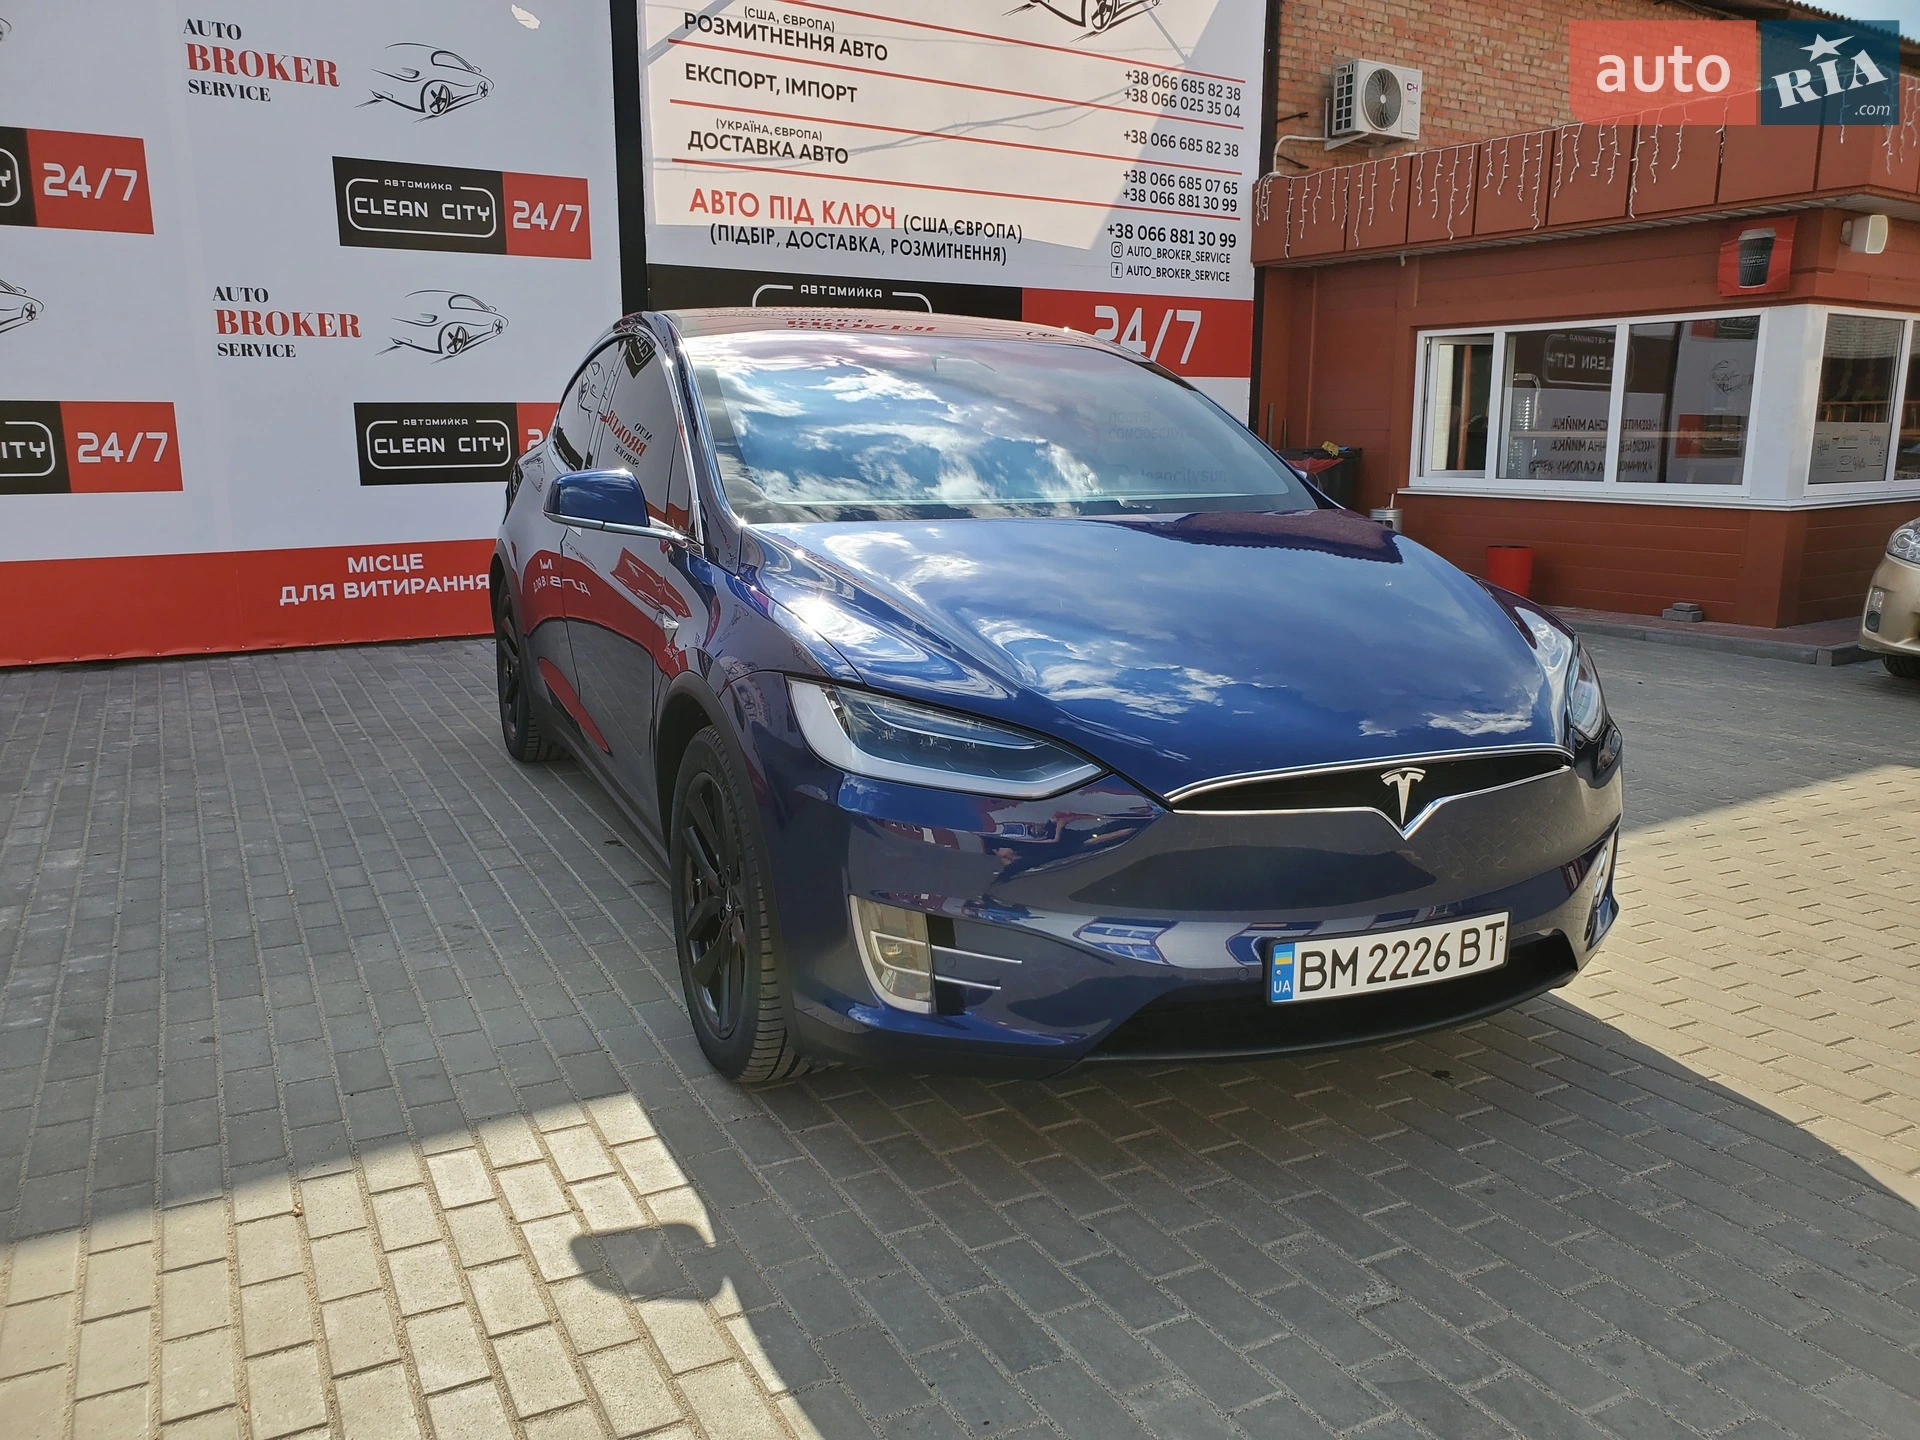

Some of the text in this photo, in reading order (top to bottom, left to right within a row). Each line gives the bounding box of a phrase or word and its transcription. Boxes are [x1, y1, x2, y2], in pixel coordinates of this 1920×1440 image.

[183, 18, 242, 40] AUTO
[744, 6, 835, 33] (США, ЄВРОПА)
[684, 11, 888, 61] РОЗМИТНЕННЯ АВТО
[185, 42, 341, 88] BROKER
[188, 79, 272, 102] SERVICE
[685, 62, 858, 102] ЕКСПОРТ, ІМПОРТ
[1125, 70, 1241, 101] +38 066 685 82 38
[1124, 88, 1240, 118] +38 066 025 35 04
[687, 130, 848, 164] ДОСТАВКА АВТО
[1123, 129, 1239, 157] +38 066 685 82 38
[43, 162, 138, 201] 24/7
[384, 179, 453, 191] АВТОМИЙКА
[1123, 169, 1238, 195] +38 066 685 07 65
[354, 197, 490, 222] CLEAN CITY
[689, 188, 760, 218] АВТО
[769, 195, 815, 226] ПІД
[822, 200, 896, 229] КЛЮЧ
[1123, 188, 1237, 212] +38 066 881 30 99
[512, 200, 582, 233] 24/7
[709, 222, 1007, 266] (ПІДБІР, ДОСТАВКА, РОЗМИТНЕННЯ)
[1107, 223, 1237, 248] +38 066 881 30 99
[1126, 245, 1231, 264] AUTO_BROKER_SERVICE
[1126, 265, 1230, 282] AUTO_BROKER_SERVICE
[212, 286, 269, 303] AUTO
[800, 284, 883, 298] АВТОМИЙКА
[214, 309, 362, 338] BROKER
[1094, 305, 1202, 365] 24/7
[217, 343, 297, 358] SERVICE
[403, 418, 468, 426] АВТОМИЙКА
[0, 441, 46, 459] ITY
[77, 432, 168, 463] 24/7
[374, 436, 505, 454] CLEAN CITY
[347, 553, 424, 574] МІСЦЕ
[279, 573, 490, 606] ДЛЯ ВИТИРАННЯ
[1299, 921, 1505, 992] BM 2226 BT
[1273, 980, 1292, 994] UA
